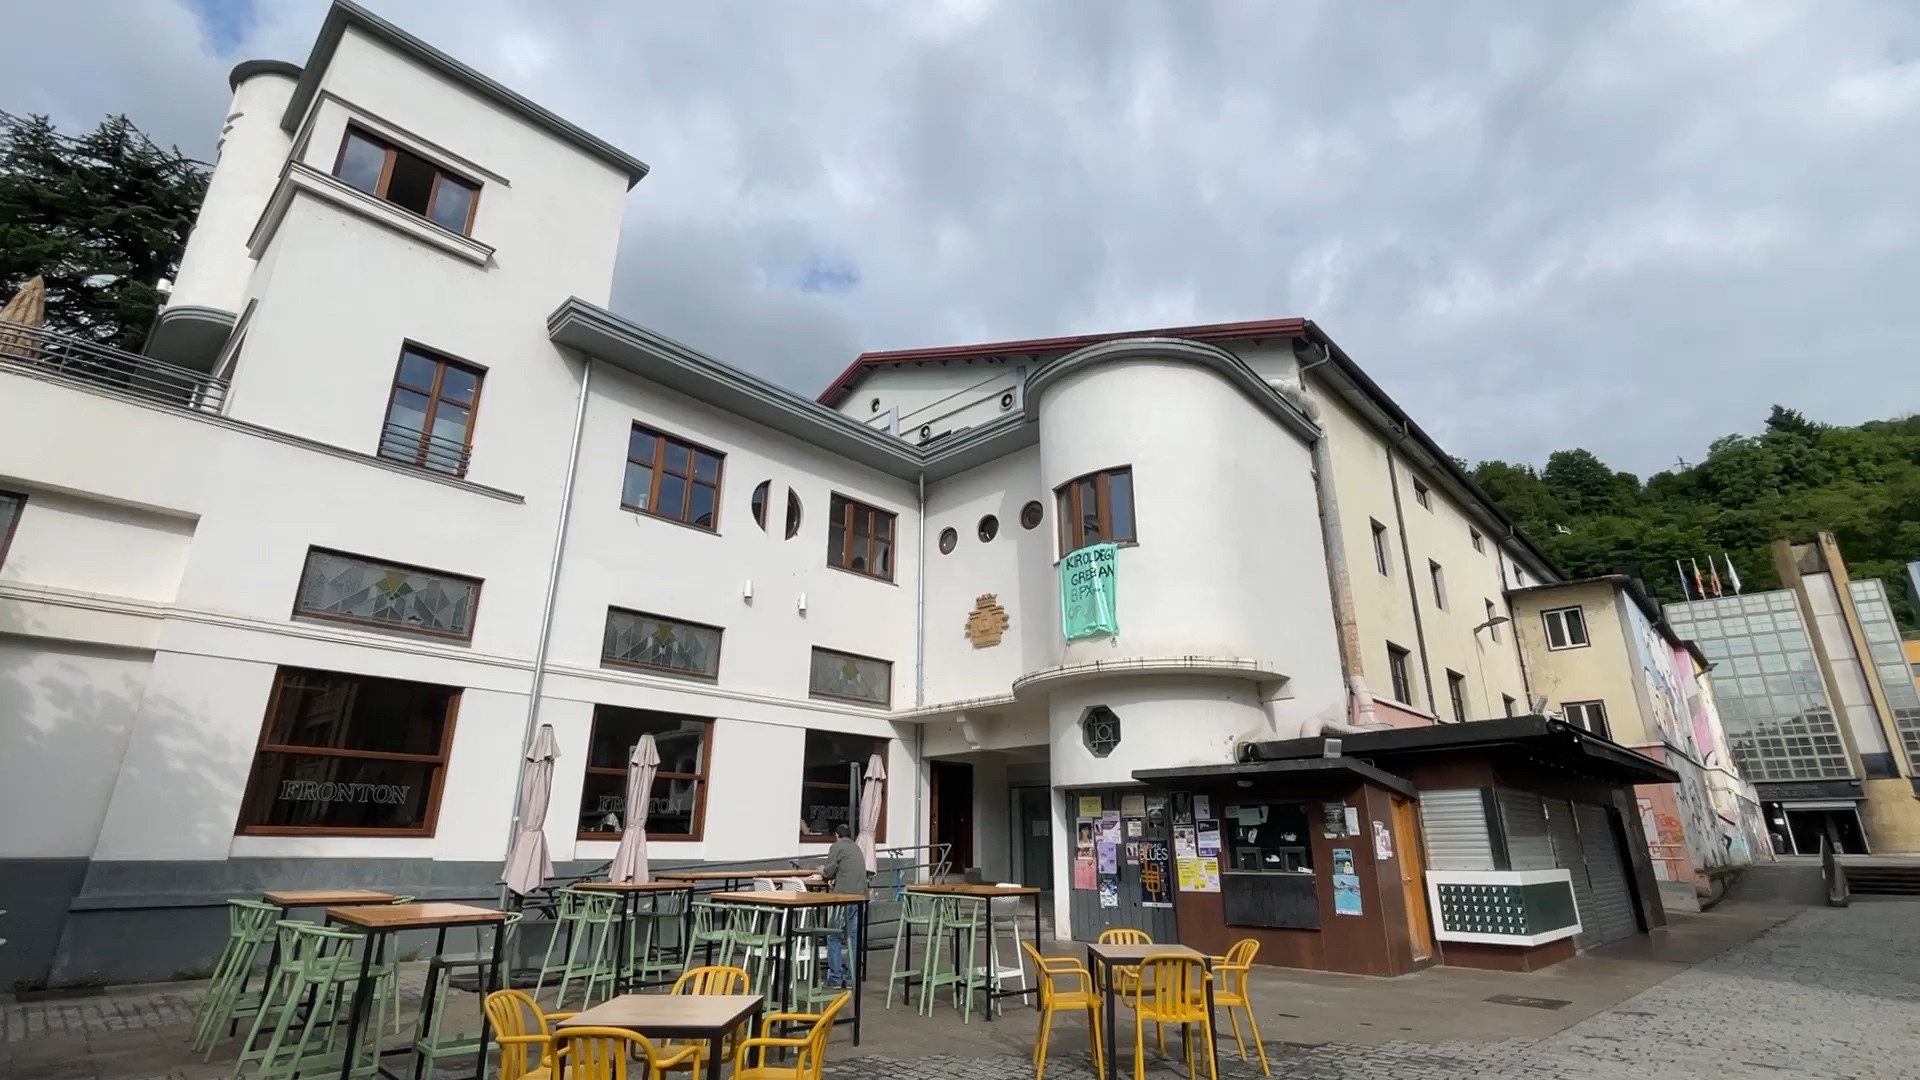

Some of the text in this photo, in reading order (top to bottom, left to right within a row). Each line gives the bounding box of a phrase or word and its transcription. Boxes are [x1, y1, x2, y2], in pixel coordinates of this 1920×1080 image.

[278, 779, 411, 805] FRONTON
[597, 795, 683, 816] FRTON
[1139, 847, 1169, 861] BLUES
